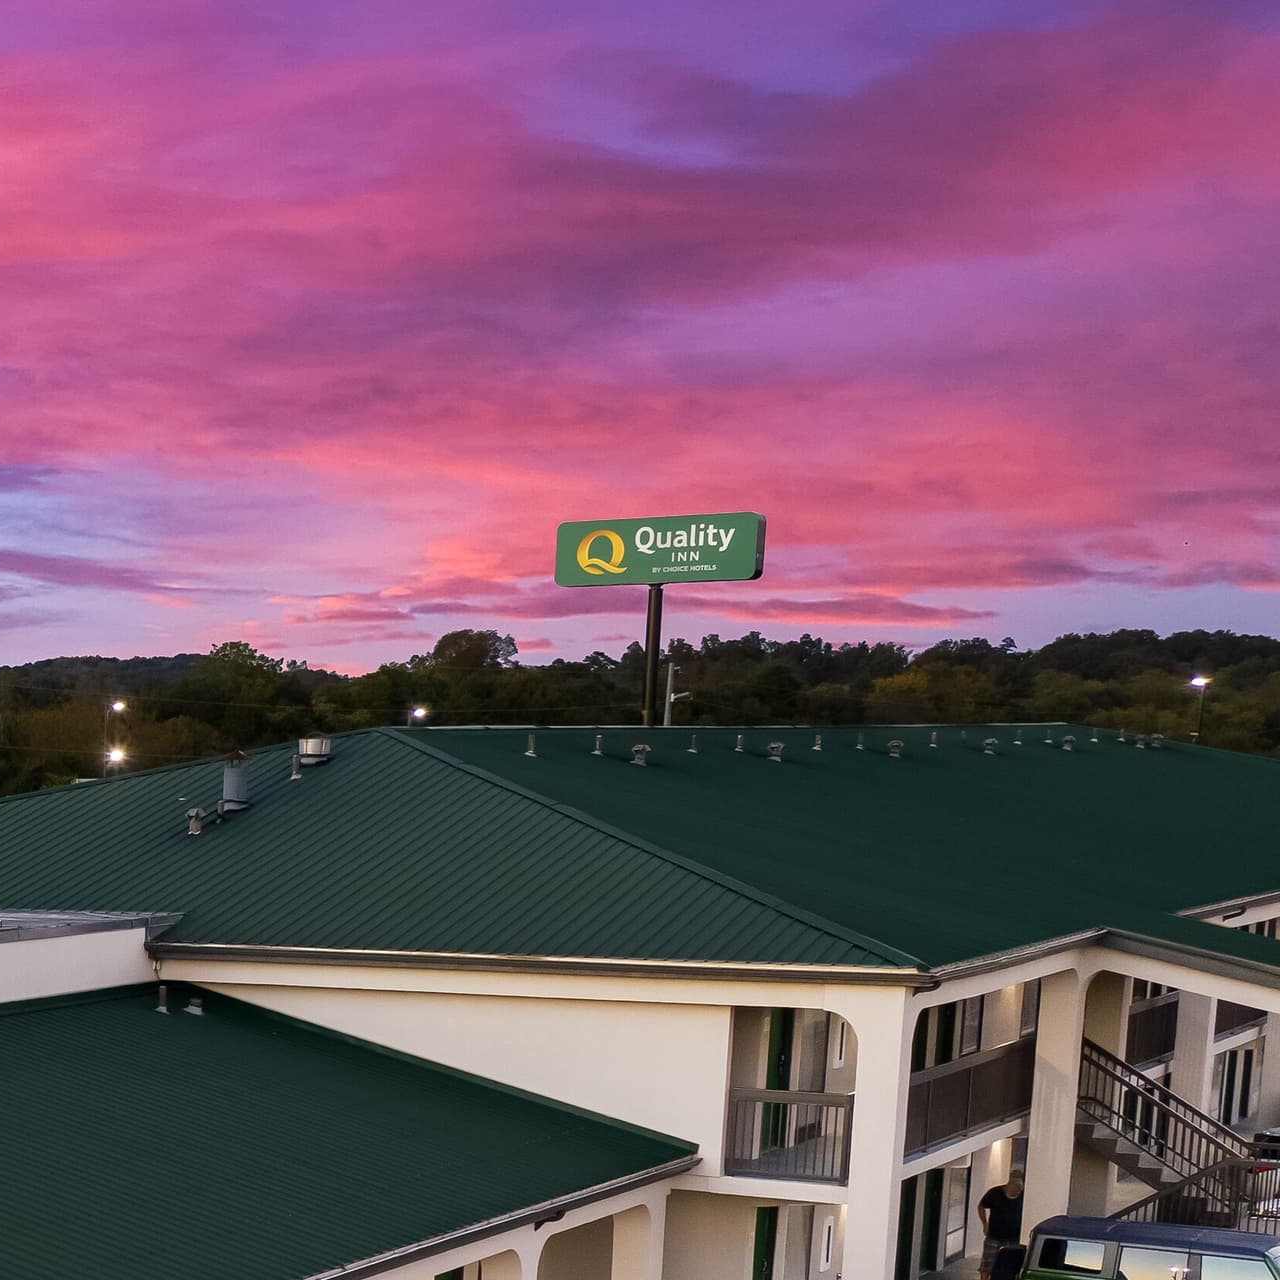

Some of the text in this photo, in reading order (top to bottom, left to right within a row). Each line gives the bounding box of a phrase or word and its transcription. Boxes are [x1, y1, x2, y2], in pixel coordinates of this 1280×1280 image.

[635, 523, 736, 554] Quality
[576, 529, 628, 575] Q
[671, 551, 700, 562] INN
[662, 565, 689, 573] CHOICE
